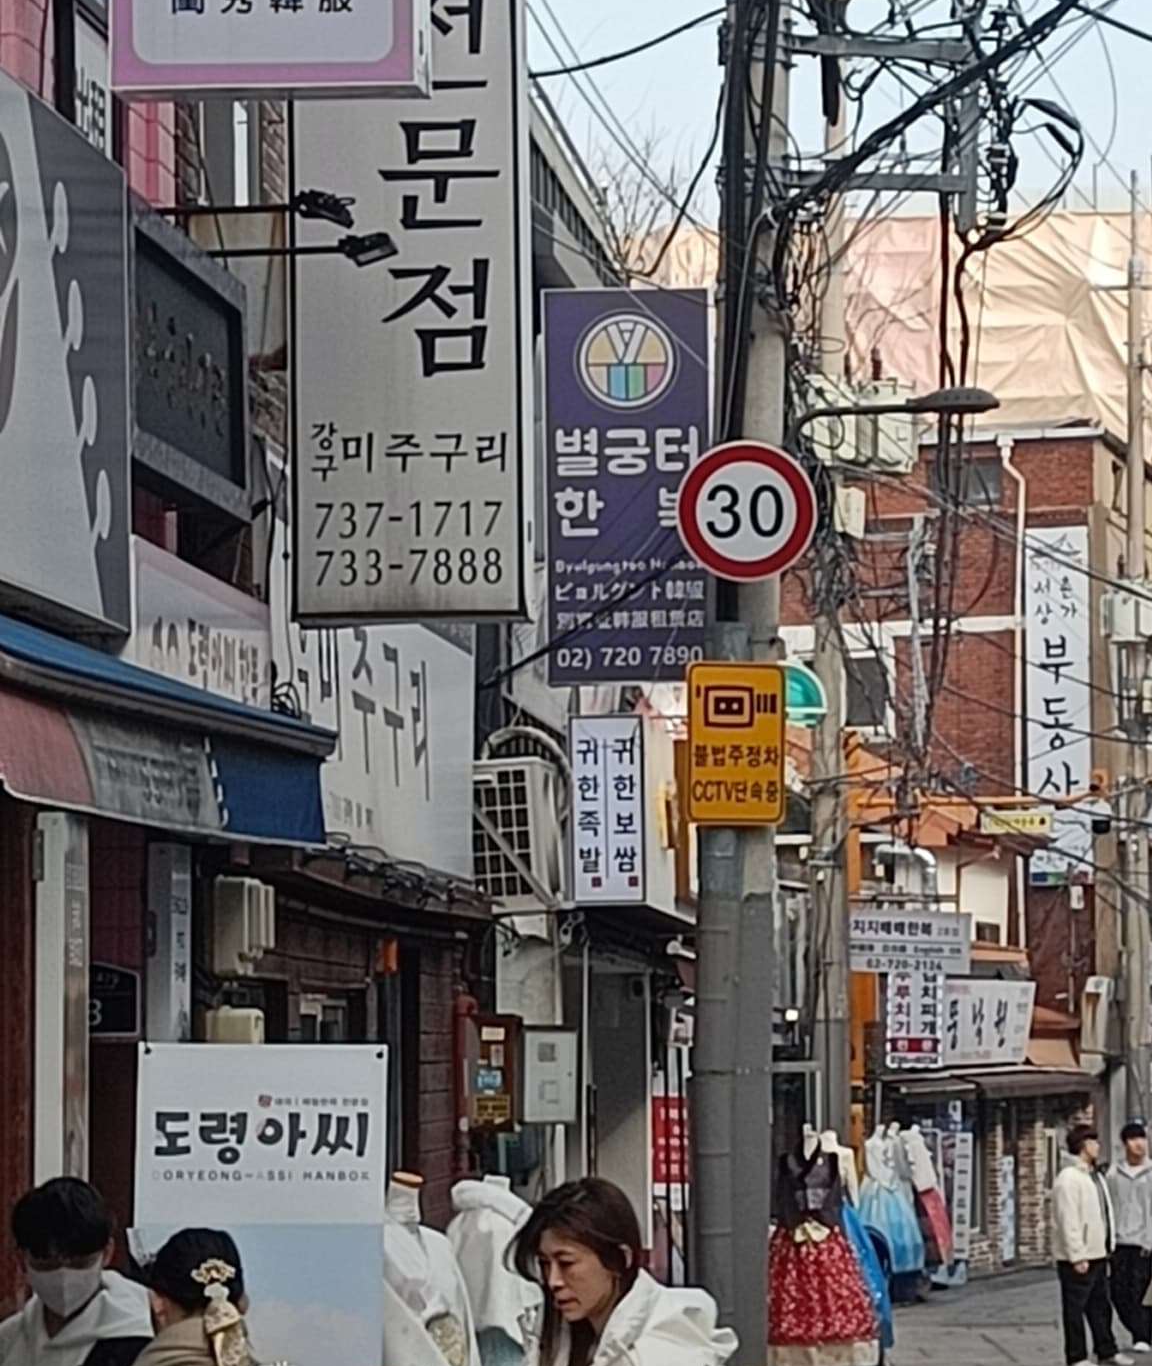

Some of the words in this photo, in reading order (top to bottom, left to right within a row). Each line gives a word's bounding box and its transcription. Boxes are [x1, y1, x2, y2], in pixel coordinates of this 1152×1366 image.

[342, 431, 507, 473] 미주구리
[555, 424, 698, 476] 별궁터
[315, 499, 503, 539] 737-1717
[704, 483, 784, 537] 30
[316, 548, 503, 586] 733-7888
[557, 648, 592, 670] 02)
[600, 647, 642, 667] 720
[650, 646, 704, 666] 7890
[694, 744, 779, 767] 불법주정차
[576, 738, 602, 874] 귀한족발
[611, 737, 637, 873] 귀한보쌈
[692, 780, 778, 803] CCTV단속중
[154, 1111, 369, 1165] 도령아씨
[302, 1170, 371, 1182] HANBOK
